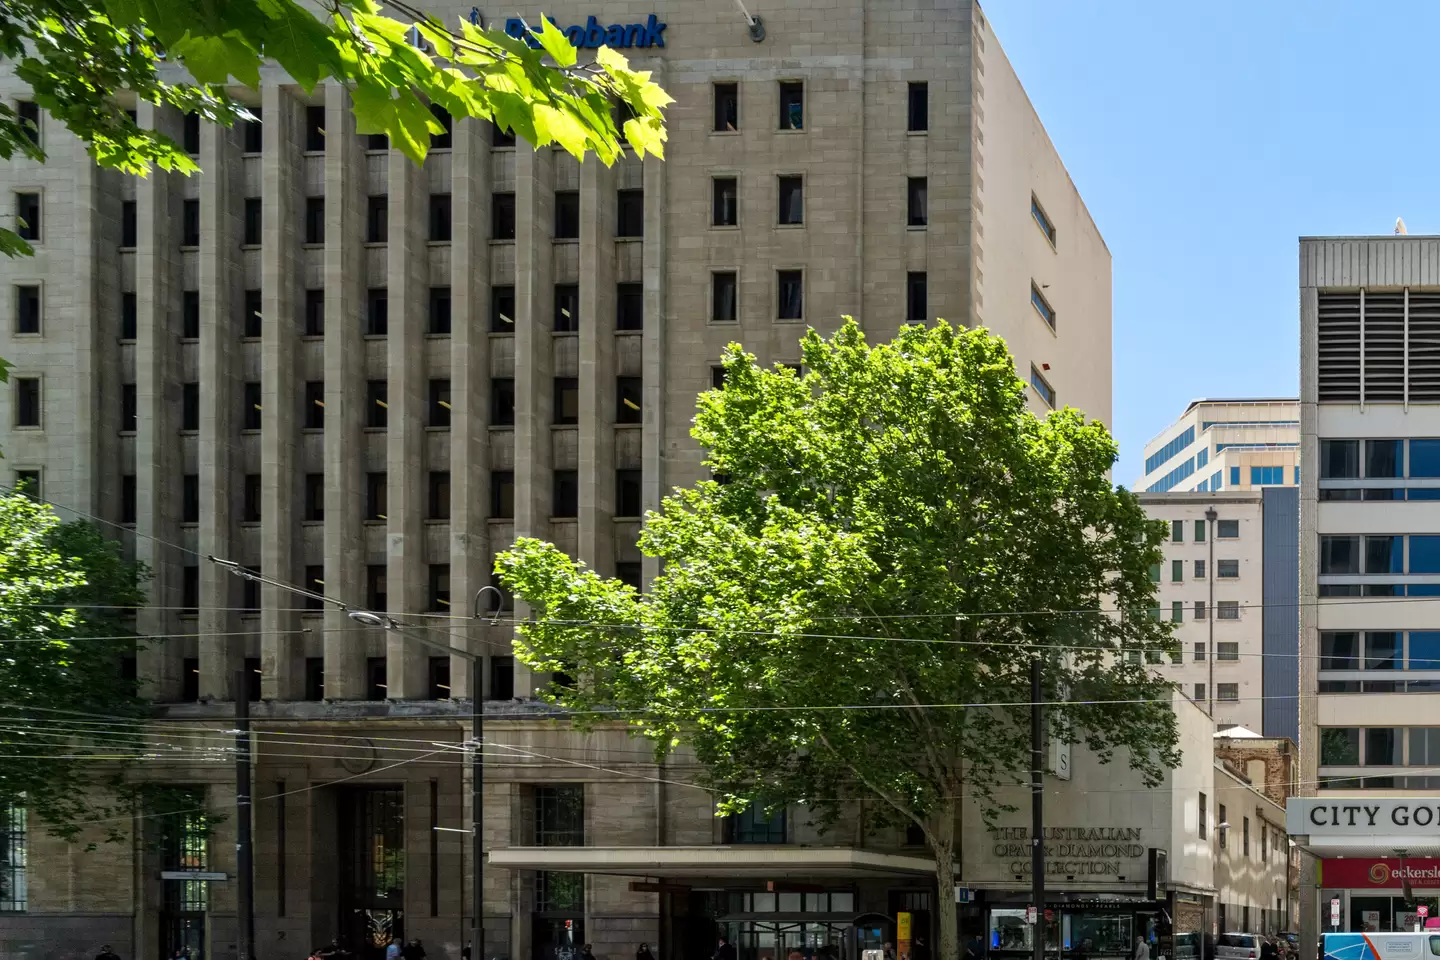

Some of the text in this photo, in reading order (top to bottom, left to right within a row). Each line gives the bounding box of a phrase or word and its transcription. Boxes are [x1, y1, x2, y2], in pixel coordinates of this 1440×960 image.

[1310, 806, 1380, 826] CITY
[994, 828, 1142, 841] THE USTRALIAN
[1057, 844, 1144, 858] DIAMOND
